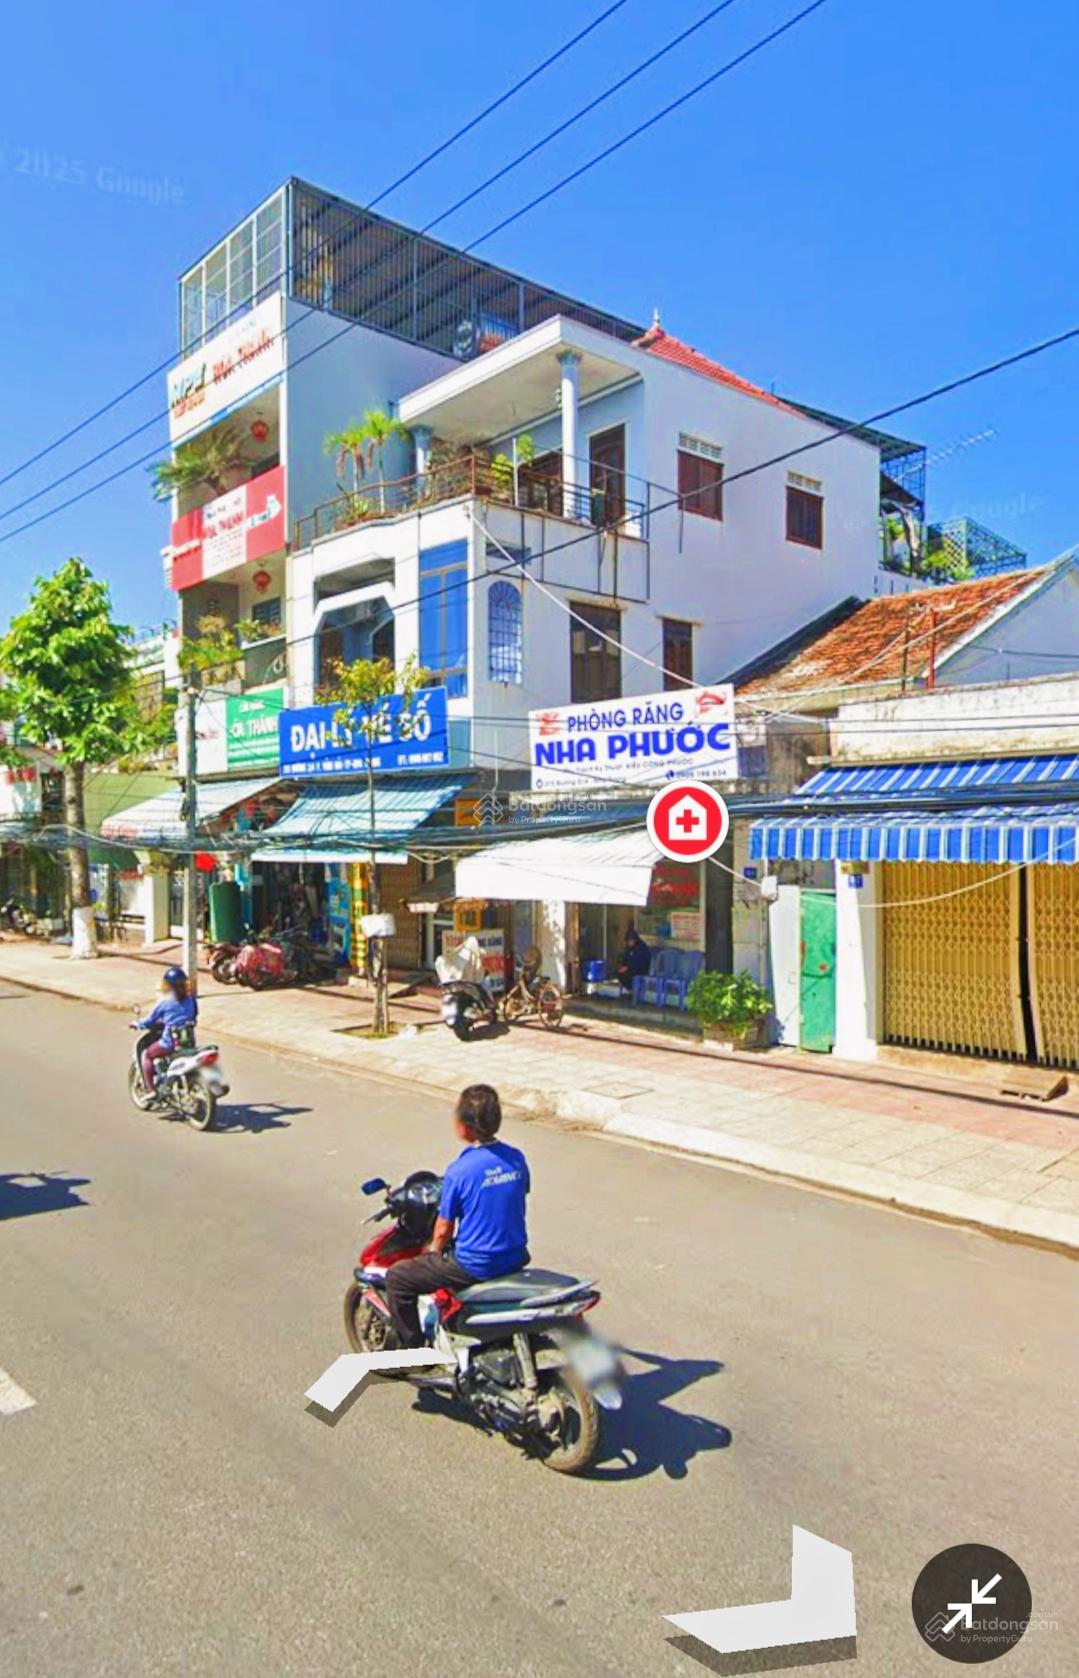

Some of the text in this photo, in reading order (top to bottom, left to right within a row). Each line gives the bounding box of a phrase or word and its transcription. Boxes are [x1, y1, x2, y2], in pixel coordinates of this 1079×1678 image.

[567, 701, 684, 732] PHÒNG RĂNG
[535, 738, 596, 766] NHA
